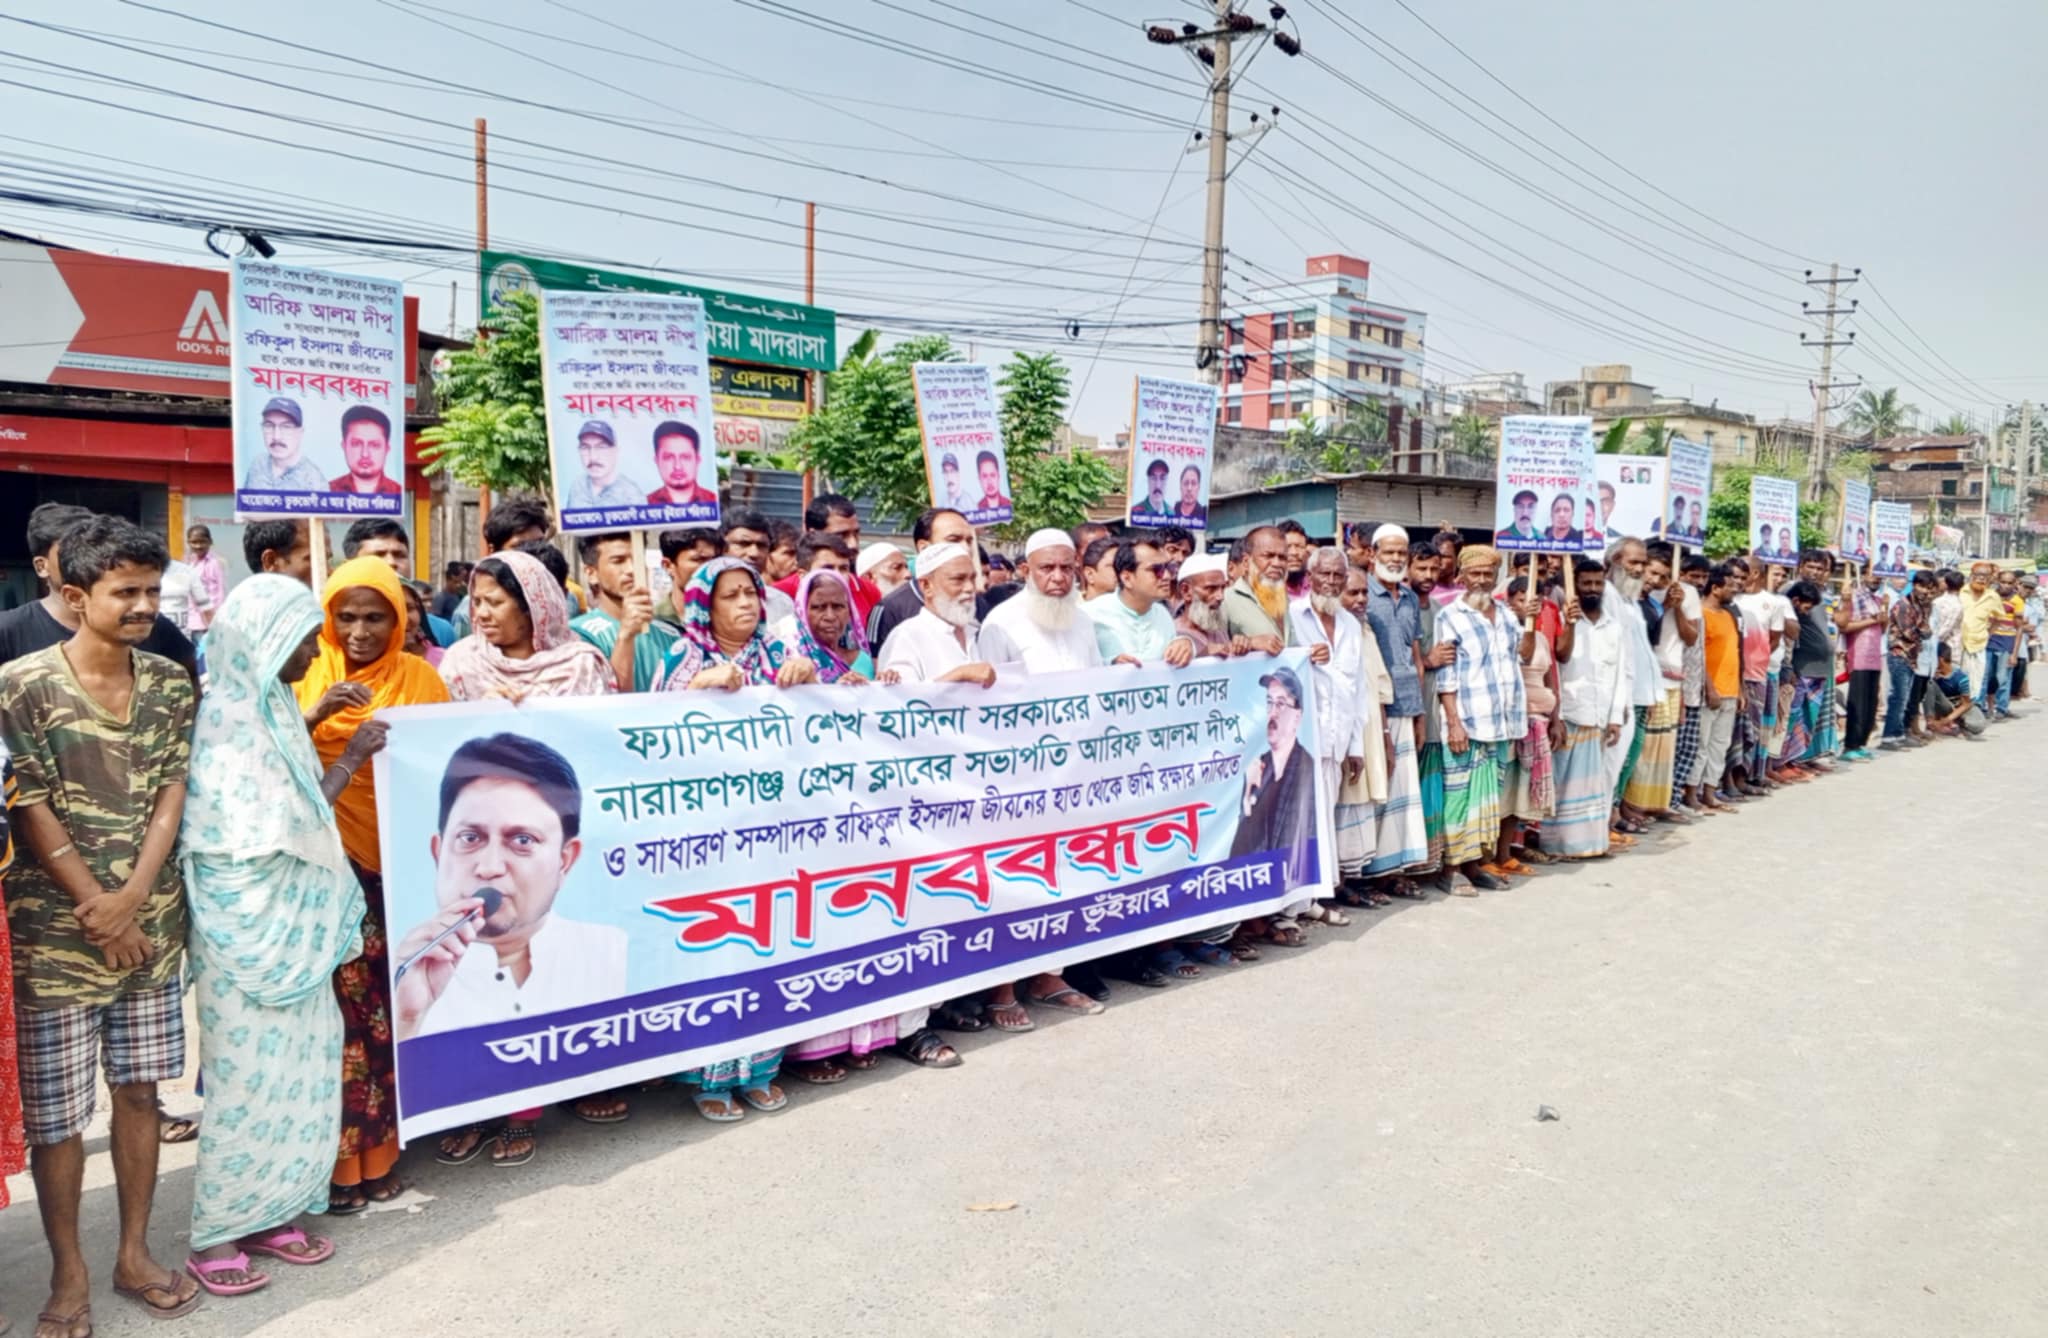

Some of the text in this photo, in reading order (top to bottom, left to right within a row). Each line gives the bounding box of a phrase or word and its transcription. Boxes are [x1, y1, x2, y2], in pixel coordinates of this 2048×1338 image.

[244, 293, 394, 337] আরিফ আলম দীপু
[176, 341, 213, 355] 100%
[245, 330, 393, 362] রফিকুল ইসলাম জীবনের
[553, 322, 698, 351] আরিফ আলম দীপু
[746, 325, 828, 364] মাদরাসা
[247, 366, 392, 400] মানববন্ধন
[558, 358, 700, 378] রফিকুল ইসলাম জীবনের
[730, 368, 800, 393] এলাকা
[562, 393, 699, 416] মানববন্ধন
[619, 678, 1229, 759] ফ্যাসিবাদী শেখ হাসিনা সরকারের অন্যতম দোসর
[594, 709, 1245, 821] নারায়ণগঞ্জ প্রেস ক্লাবের সভাপতি আরিফ আলম দীপু
[603, 751, 1242, 877] ও সাধারণ সম্পাদক রফিকুল ইসলাম জীবনের হাত থেকে জমি রক্ষার দাবিতে
[644, 801, 1216, 957] মানববন্ধন
[774, 928, 955, 1012] ভুক্তভোগী
[965, 926, 993, 953] এ
[1008, 909, 1069, 942] আর
[1080, 884, 1171, 933] ভূঁইয়ার
[1182, 861, 1274, 901] পরিবার
